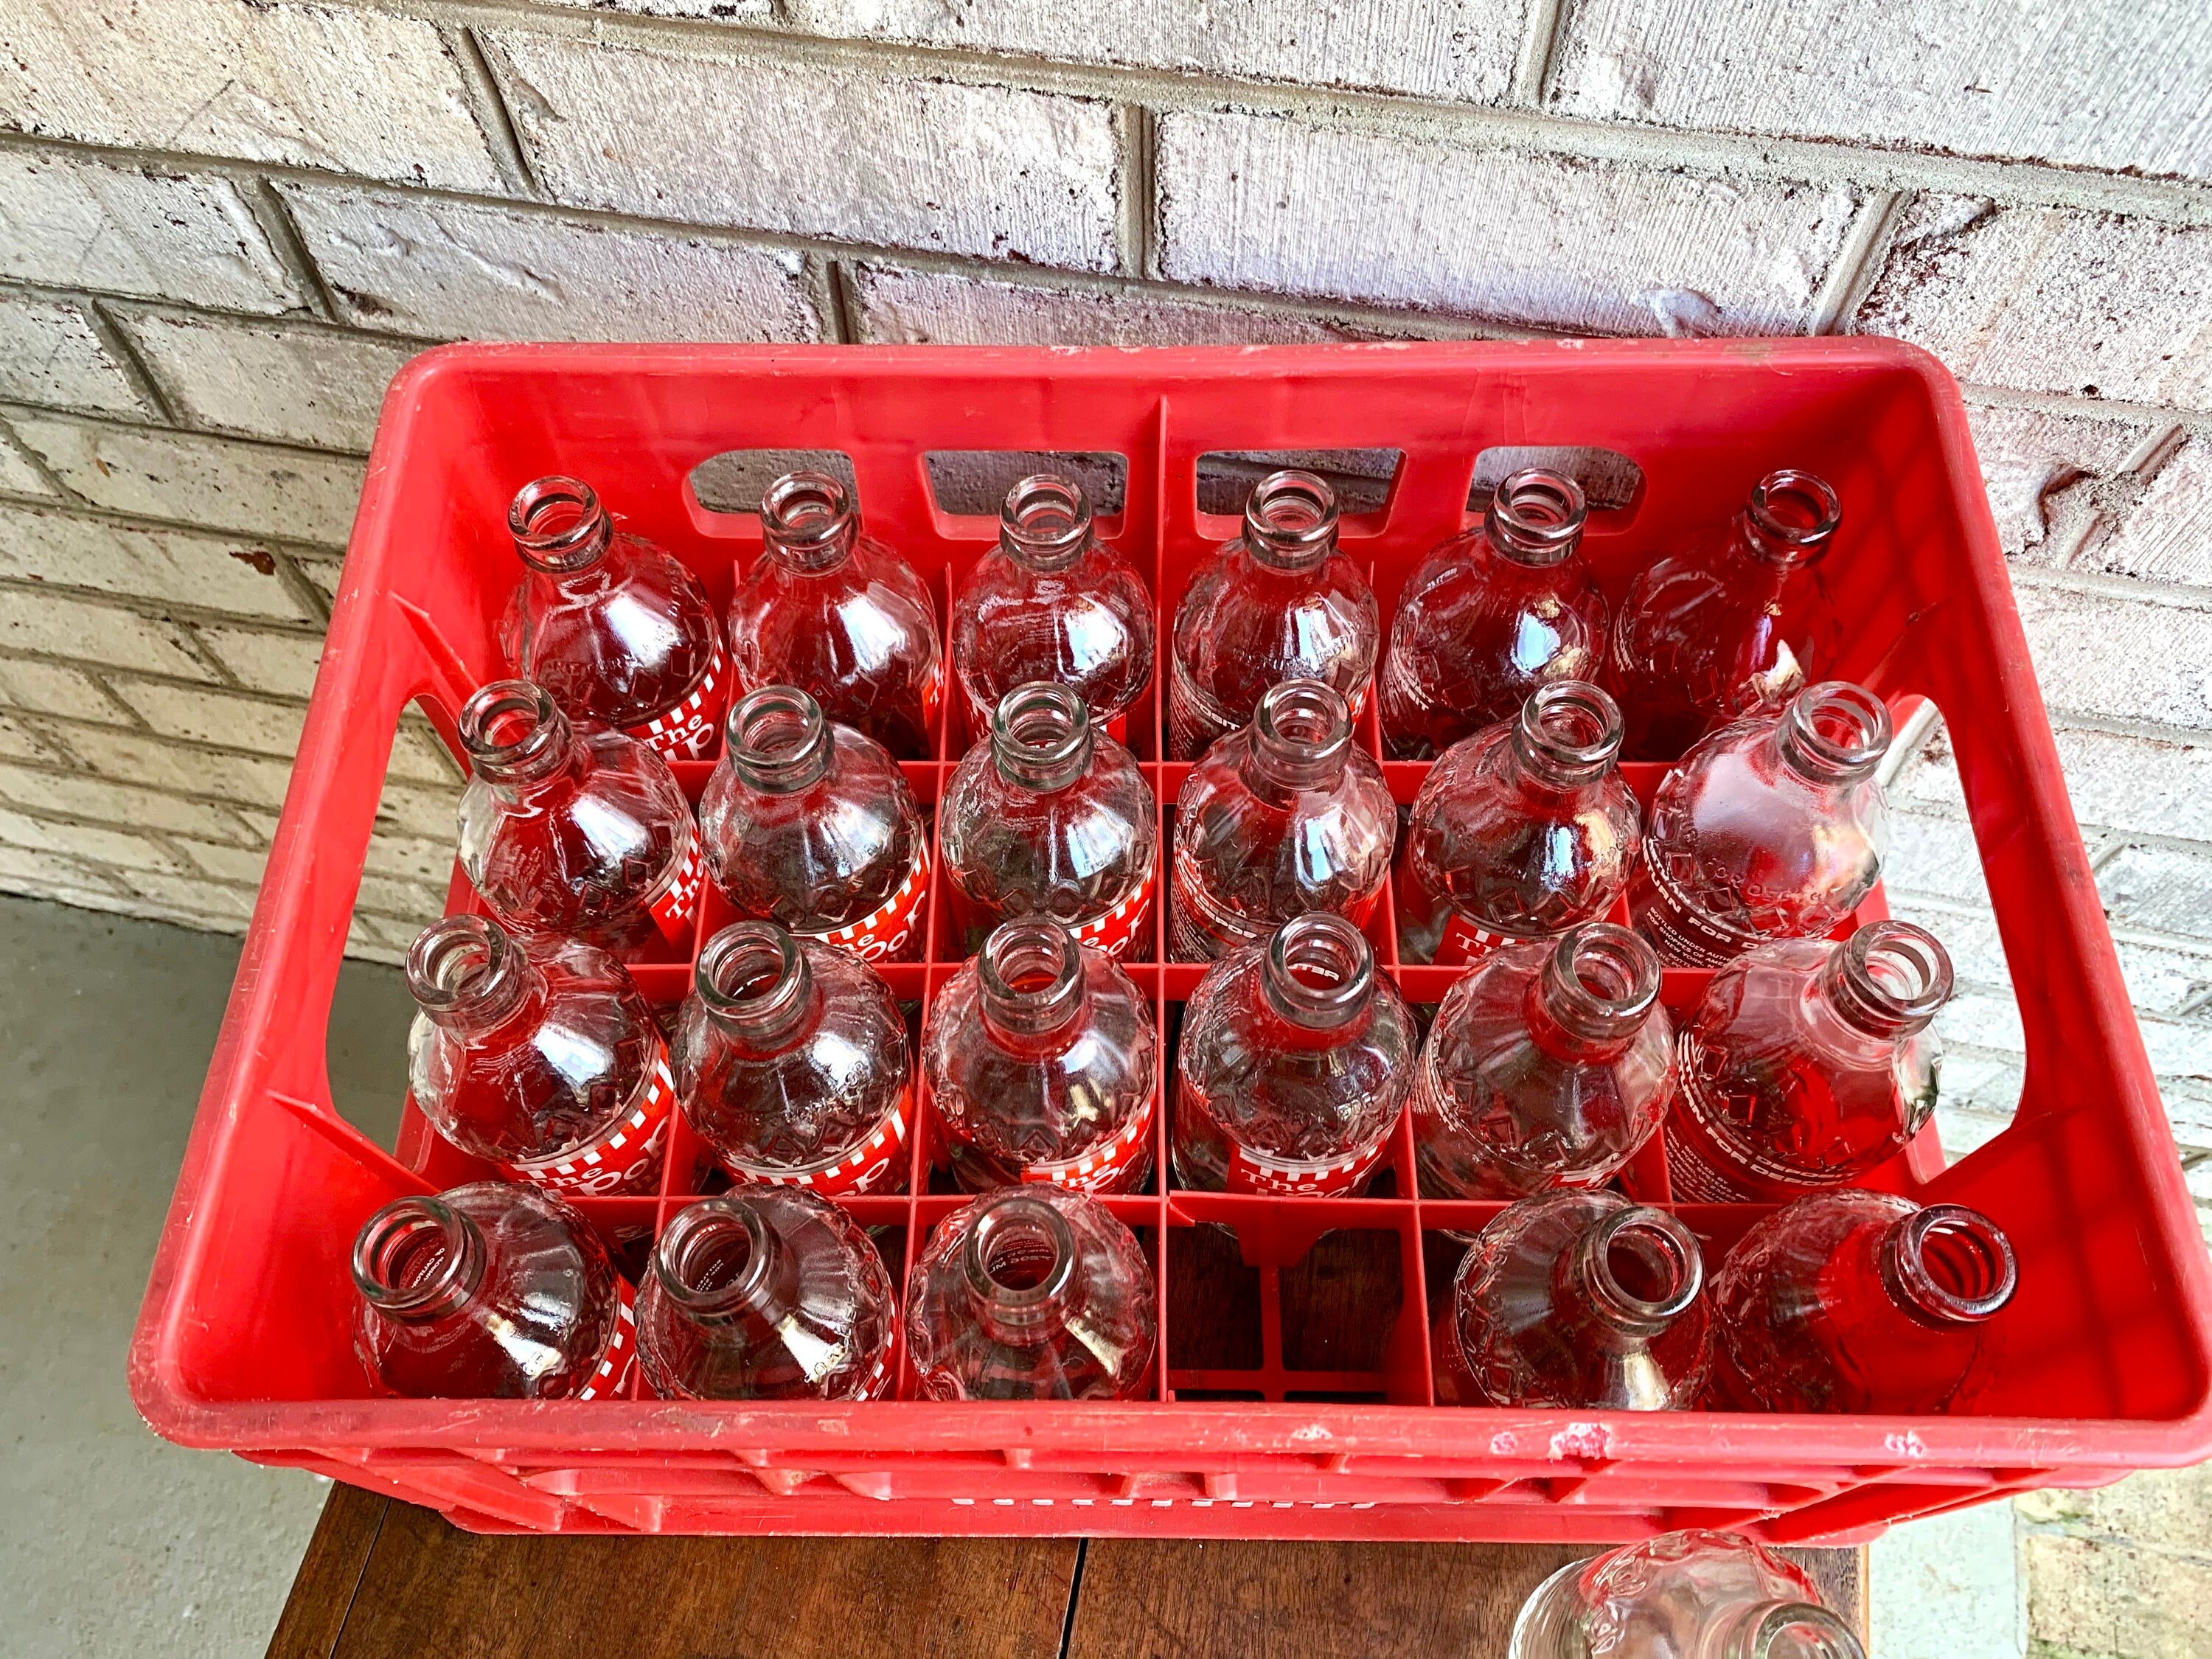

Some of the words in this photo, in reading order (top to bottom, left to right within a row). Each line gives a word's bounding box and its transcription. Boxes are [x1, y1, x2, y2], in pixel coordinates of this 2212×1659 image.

[644, 714, 703, 751] The
[1646, 911, 1659, 926] POP
[1659, 926, 1691, 953] SHOPPES
[1693, 950, 1705, 959] OF
[1649, 906, 1677, 936] BOTTLED
[1678, 935, 1705, 953] UNDER
[1706, 951, 1731, 961] AUTH
[1664, 939, 1681, 953] NEW
[1688, 916, 1732, 943] FOR
[1667, 1125, 1680, 1148] SODA
[1681, 1150, 1694, 1164] POP
[1697, 1166, 1732, 1193] SYSTEMS
[1684, 1144, 1715, 1175] BOTTLED
[1717, 1176, 1728, 1184] BY
[1705, 1126, 1748, 1164] FOR
[1240, 1167, 1318, 1192] The
